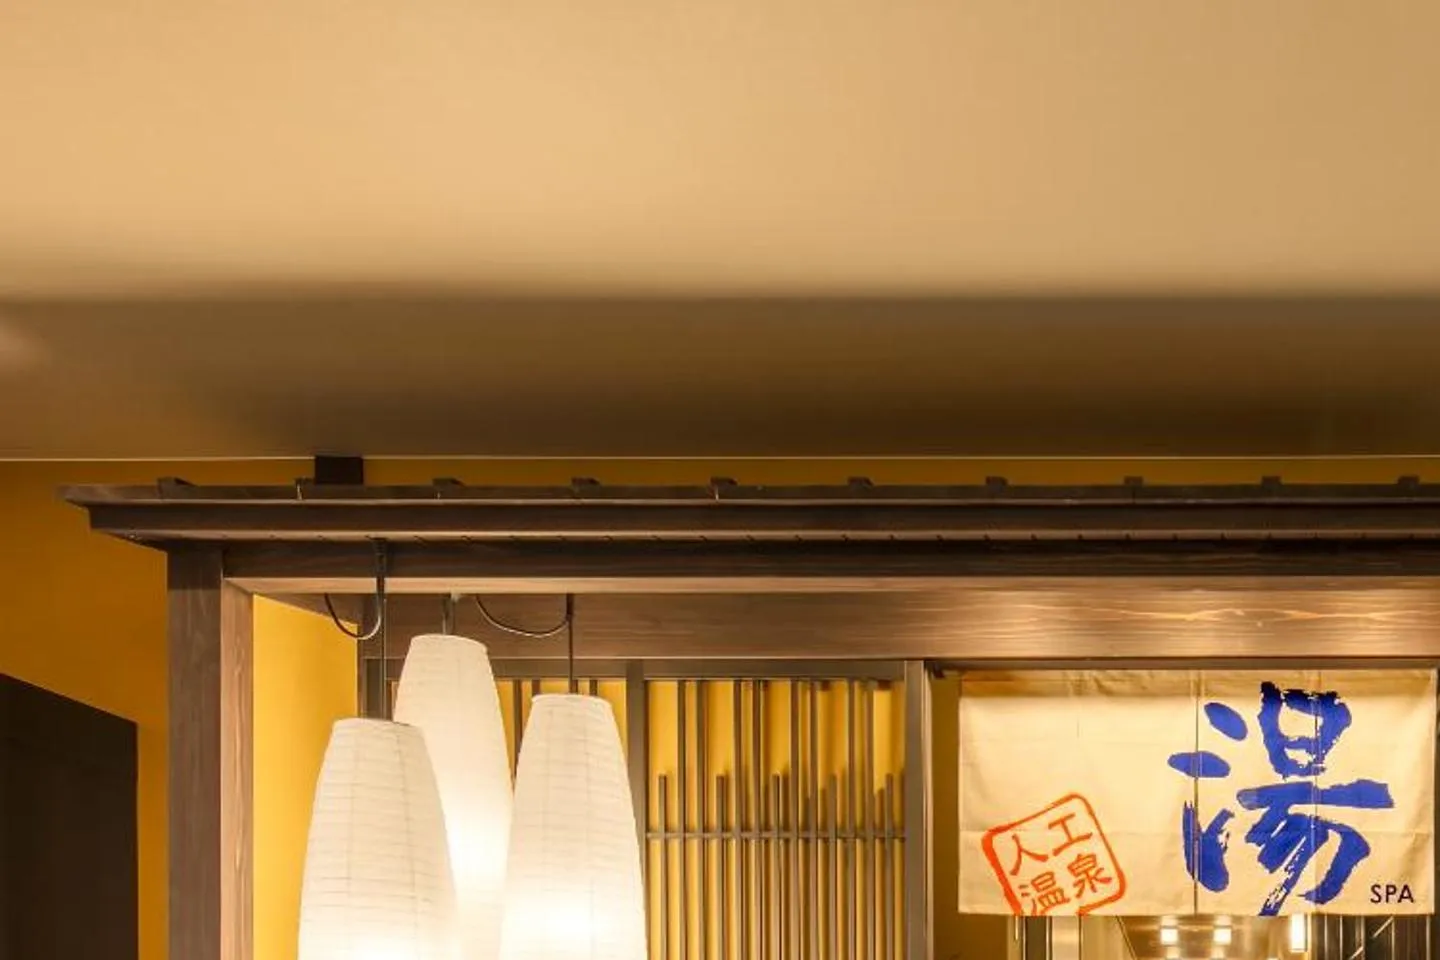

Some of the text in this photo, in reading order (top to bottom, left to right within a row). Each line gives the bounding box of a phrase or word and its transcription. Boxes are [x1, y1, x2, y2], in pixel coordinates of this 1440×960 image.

[1167, 681, 1395, 916] 湯
[1010, 812, 1093, 876] 人工
[1018, 853, 1113, 917] 温泉
[1370, 884, 1414, 904] SPA
